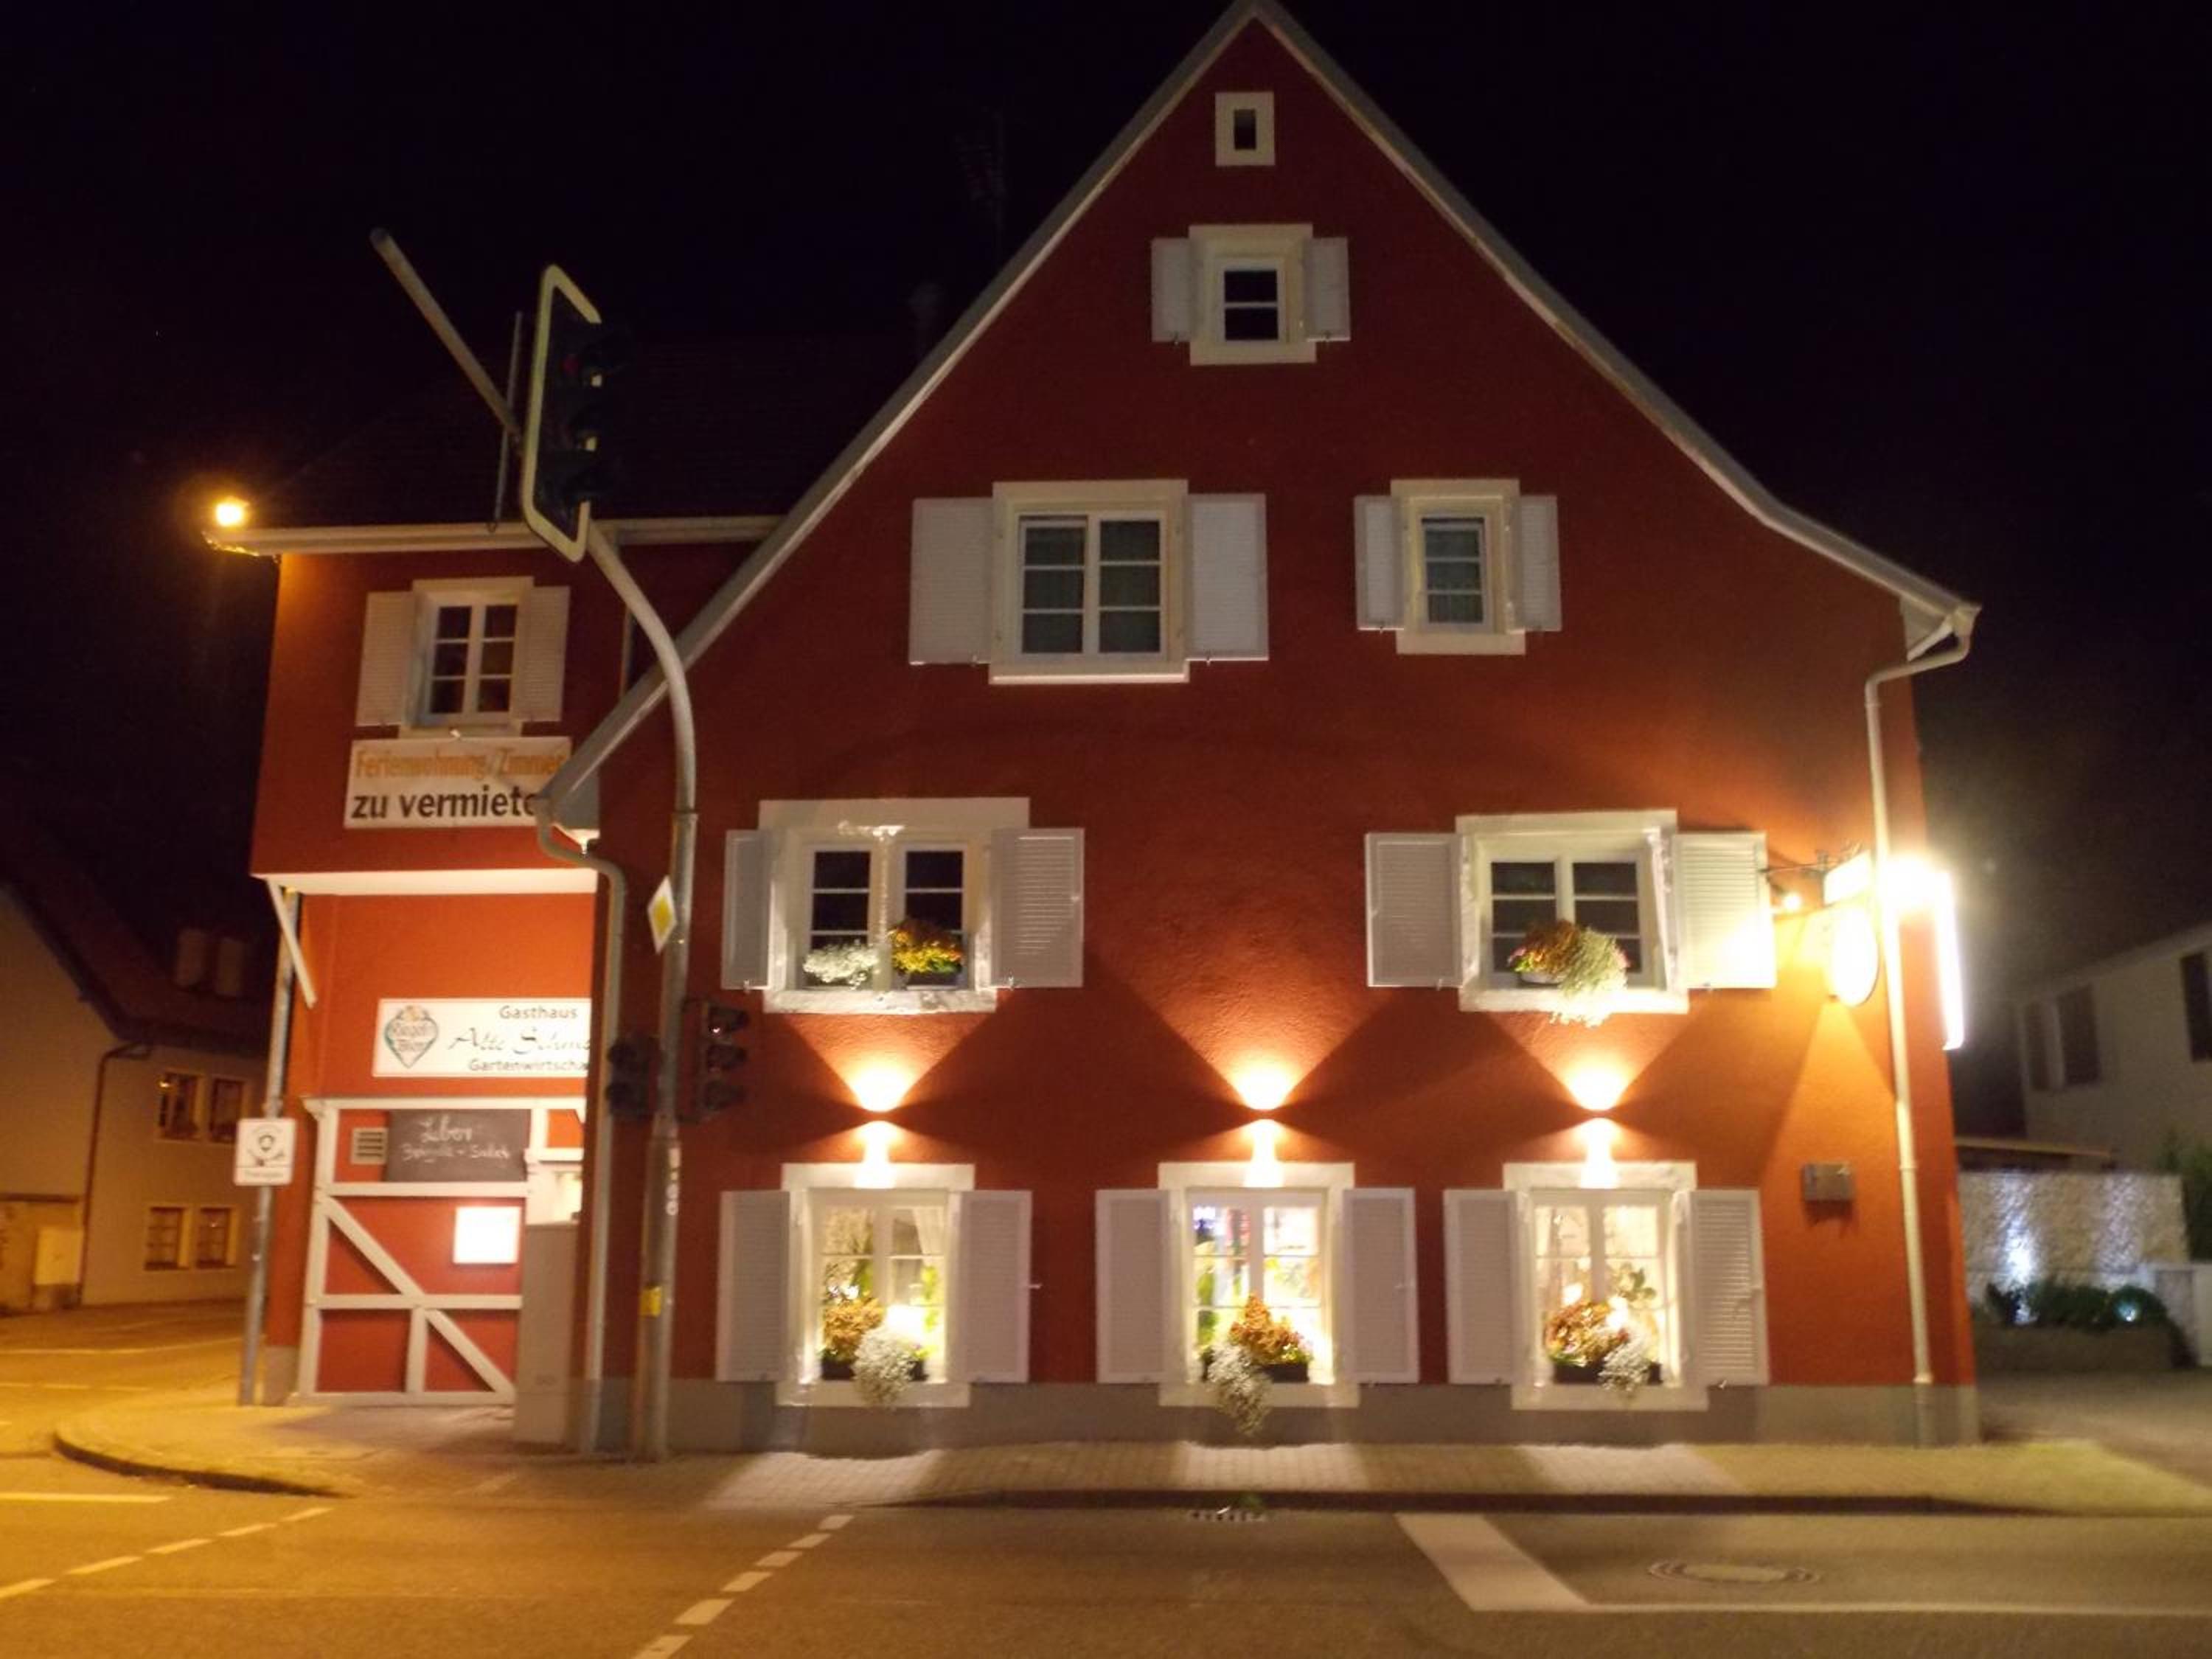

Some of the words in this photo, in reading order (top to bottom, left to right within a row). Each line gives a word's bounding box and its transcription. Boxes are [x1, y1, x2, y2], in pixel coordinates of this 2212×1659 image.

[352, 795, 388, 818] zu
[399, 785, 537, 818] vermiete
[498, 1005, 578, 1020] Gasthaus
[468, 1057, 589, 1072] Gartenwirtscha
